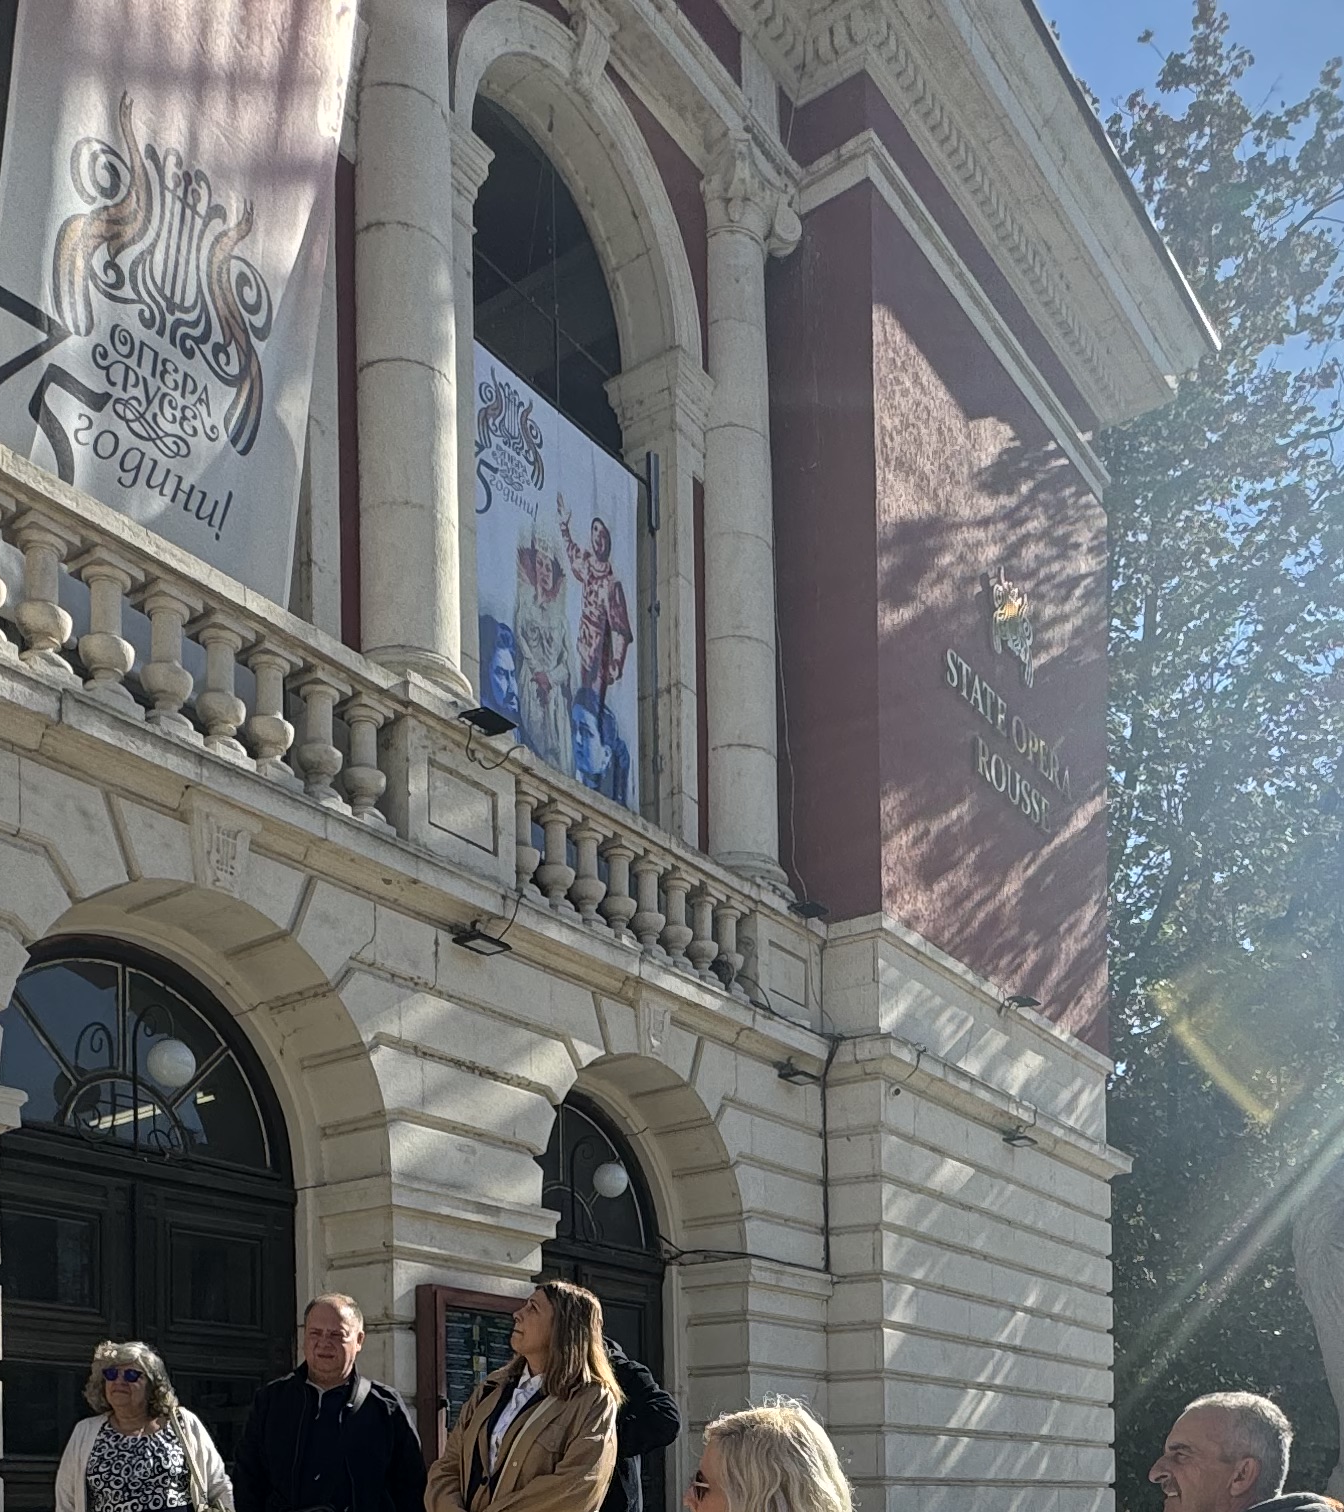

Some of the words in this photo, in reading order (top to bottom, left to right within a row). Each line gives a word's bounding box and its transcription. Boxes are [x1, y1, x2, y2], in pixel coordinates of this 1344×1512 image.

[91, 343, 220, 442] РУСЕ
[109, 323, 213, 418] ОПЕРА
[72, 413, 234, 541] години!
[489, 474, 539, 523] години!
[945, 647, 1008, 737] STATE
[1011, 714, 1073, 802] OPERA
[975, 734, 1052, 833] ROUSSE
